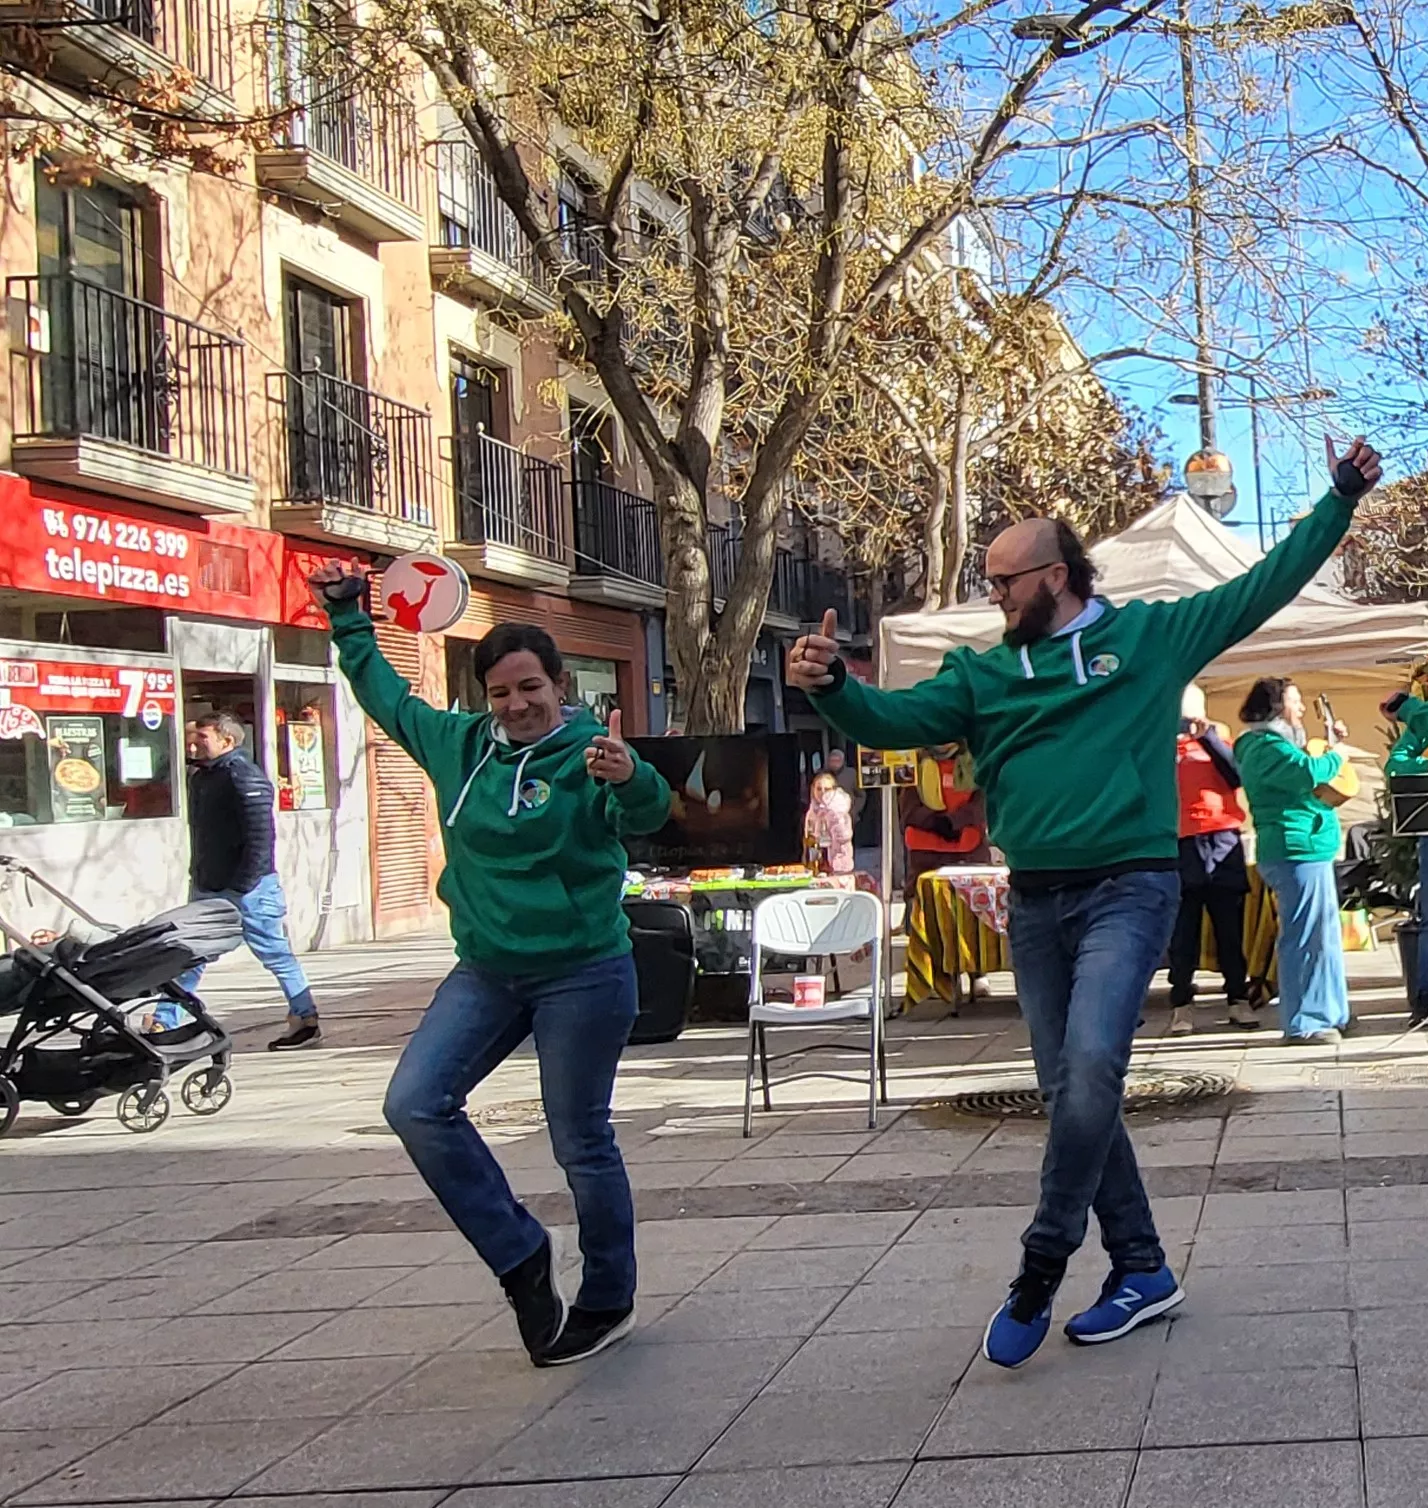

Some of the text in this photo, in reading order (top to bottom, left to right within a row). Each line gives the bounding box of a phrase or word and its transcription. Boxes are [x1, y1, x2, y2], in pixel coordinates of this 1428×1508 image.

[72, 514, 189, 559] 974 226 399
[45, 547, 190, 597] telepizza.es
